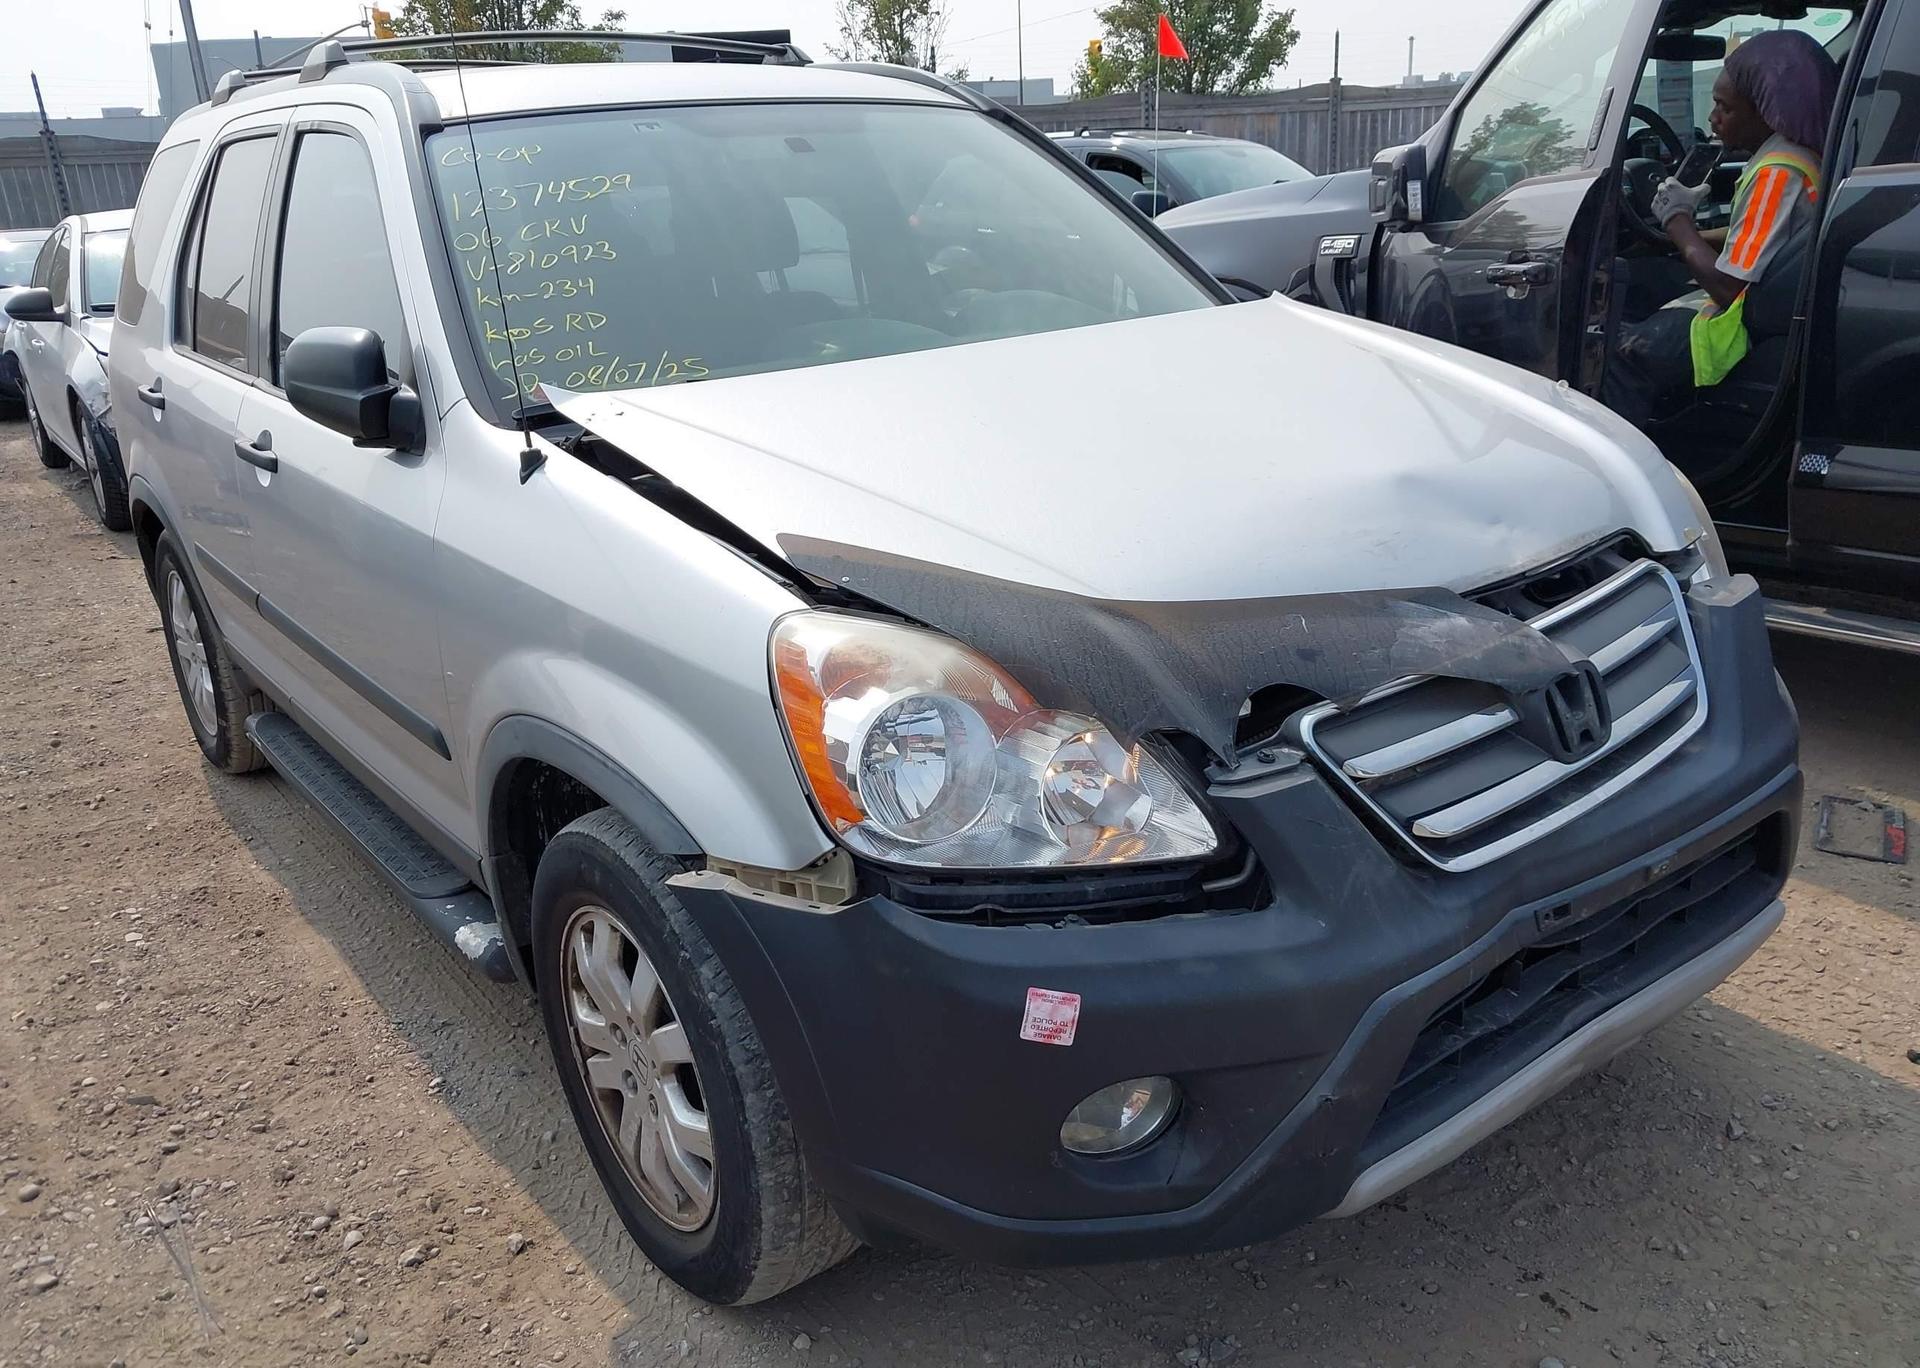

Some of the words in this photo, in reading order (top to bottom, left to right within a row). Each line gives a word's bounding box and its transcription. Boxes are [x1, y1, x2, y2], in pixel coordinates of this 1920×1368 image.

[452, 173, 632, 221] 12374529
[453, 226, 503, 251] 06
[520, 214, 588, 241] CRV
[466, 240, 617, 281] V-810923
[566, 311, 607, 333] RD
[566, 350, 710, 389] 08/07/25
[1031, 1016, 1058, 1025] POLICE
[1031, 1024, 1067, 1034] REPORTED
[1033, 1032, 1062, 1040] DAMAGE
